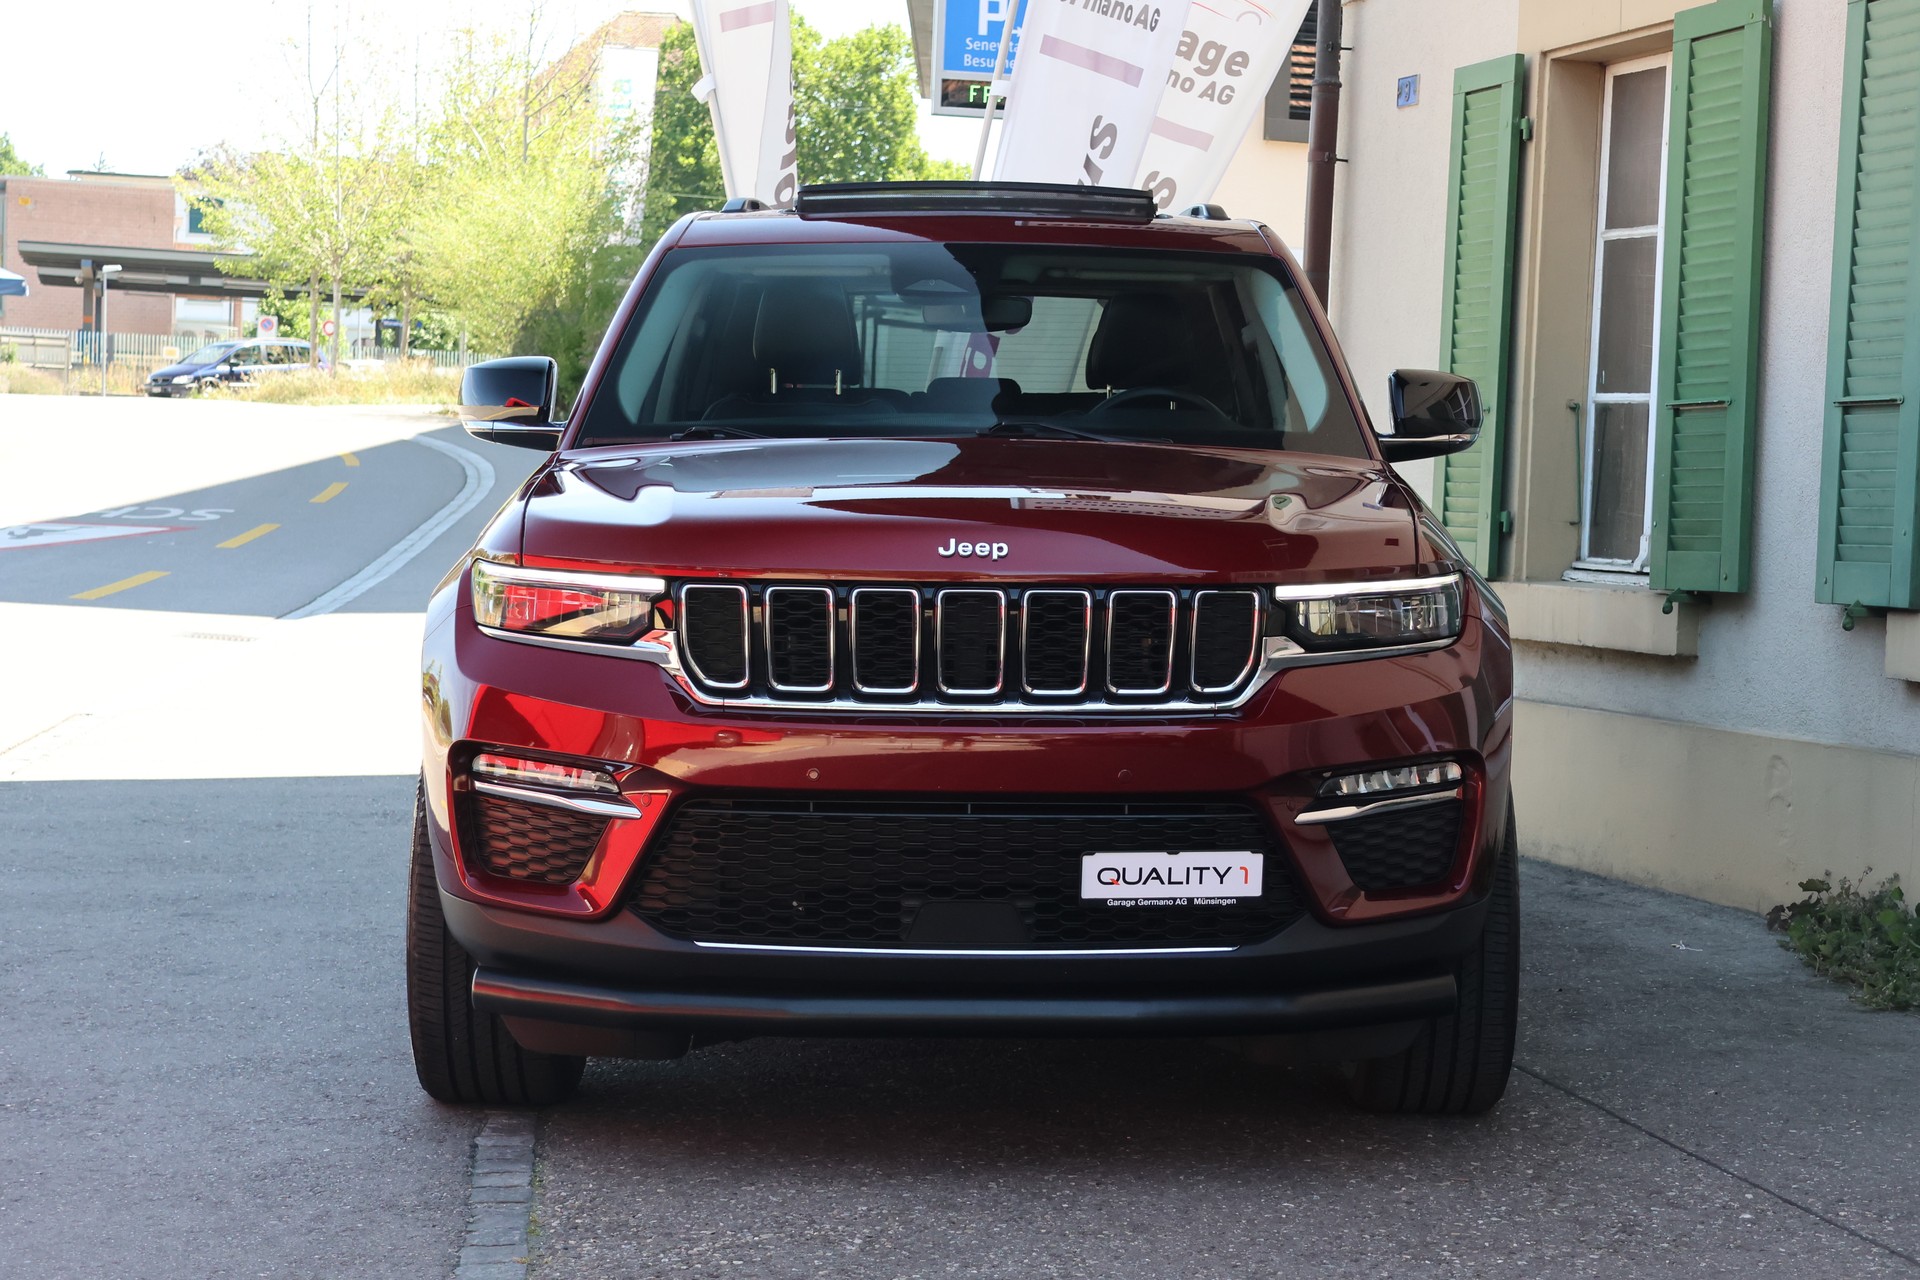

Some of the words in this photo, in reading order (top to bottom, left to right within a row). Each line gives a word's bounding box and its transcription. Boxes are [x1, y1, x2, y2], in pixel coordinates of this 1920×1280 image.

[978, 0, 1007, 36] P
[1133, 4, 1160, 32] AG
[1175, 30, 1250, 77] age
[1166, 69, 1195, 93] no
[1198, 81, 1235, 105] AG
[938, 538, 1009, 562] Jeep
[1097, 866, 1232, 885] QUALITY
[1107, 898, 1136, 907] Garage
[1137, 898, 1174, 906] Germano
[1175, 898, 1188, 906] AG
[1193, 897, 1237, 906] Münsingen
